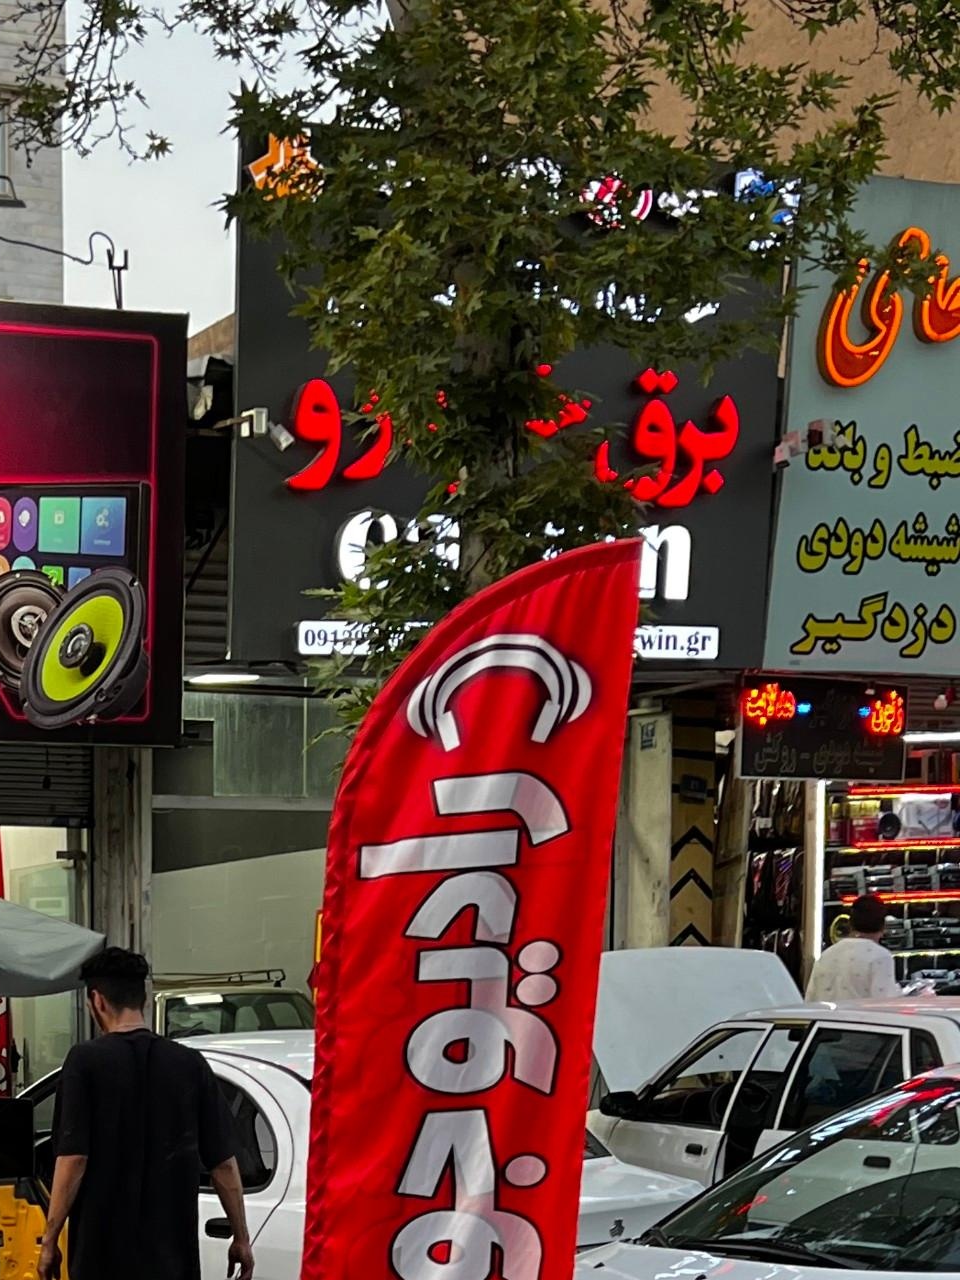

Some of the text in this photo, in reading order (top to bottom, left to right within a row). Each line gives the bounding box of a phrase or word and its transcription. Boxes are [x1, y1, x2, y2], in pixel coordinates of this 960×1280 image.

[595, 368, 739, 508] برق
[867, 443, 892, 488] و
[797, 512, 960, 576] شیشه دودی
[790, 591, 956, 658] دزدگیر
[358, 771, 571, 1097] رادیو
